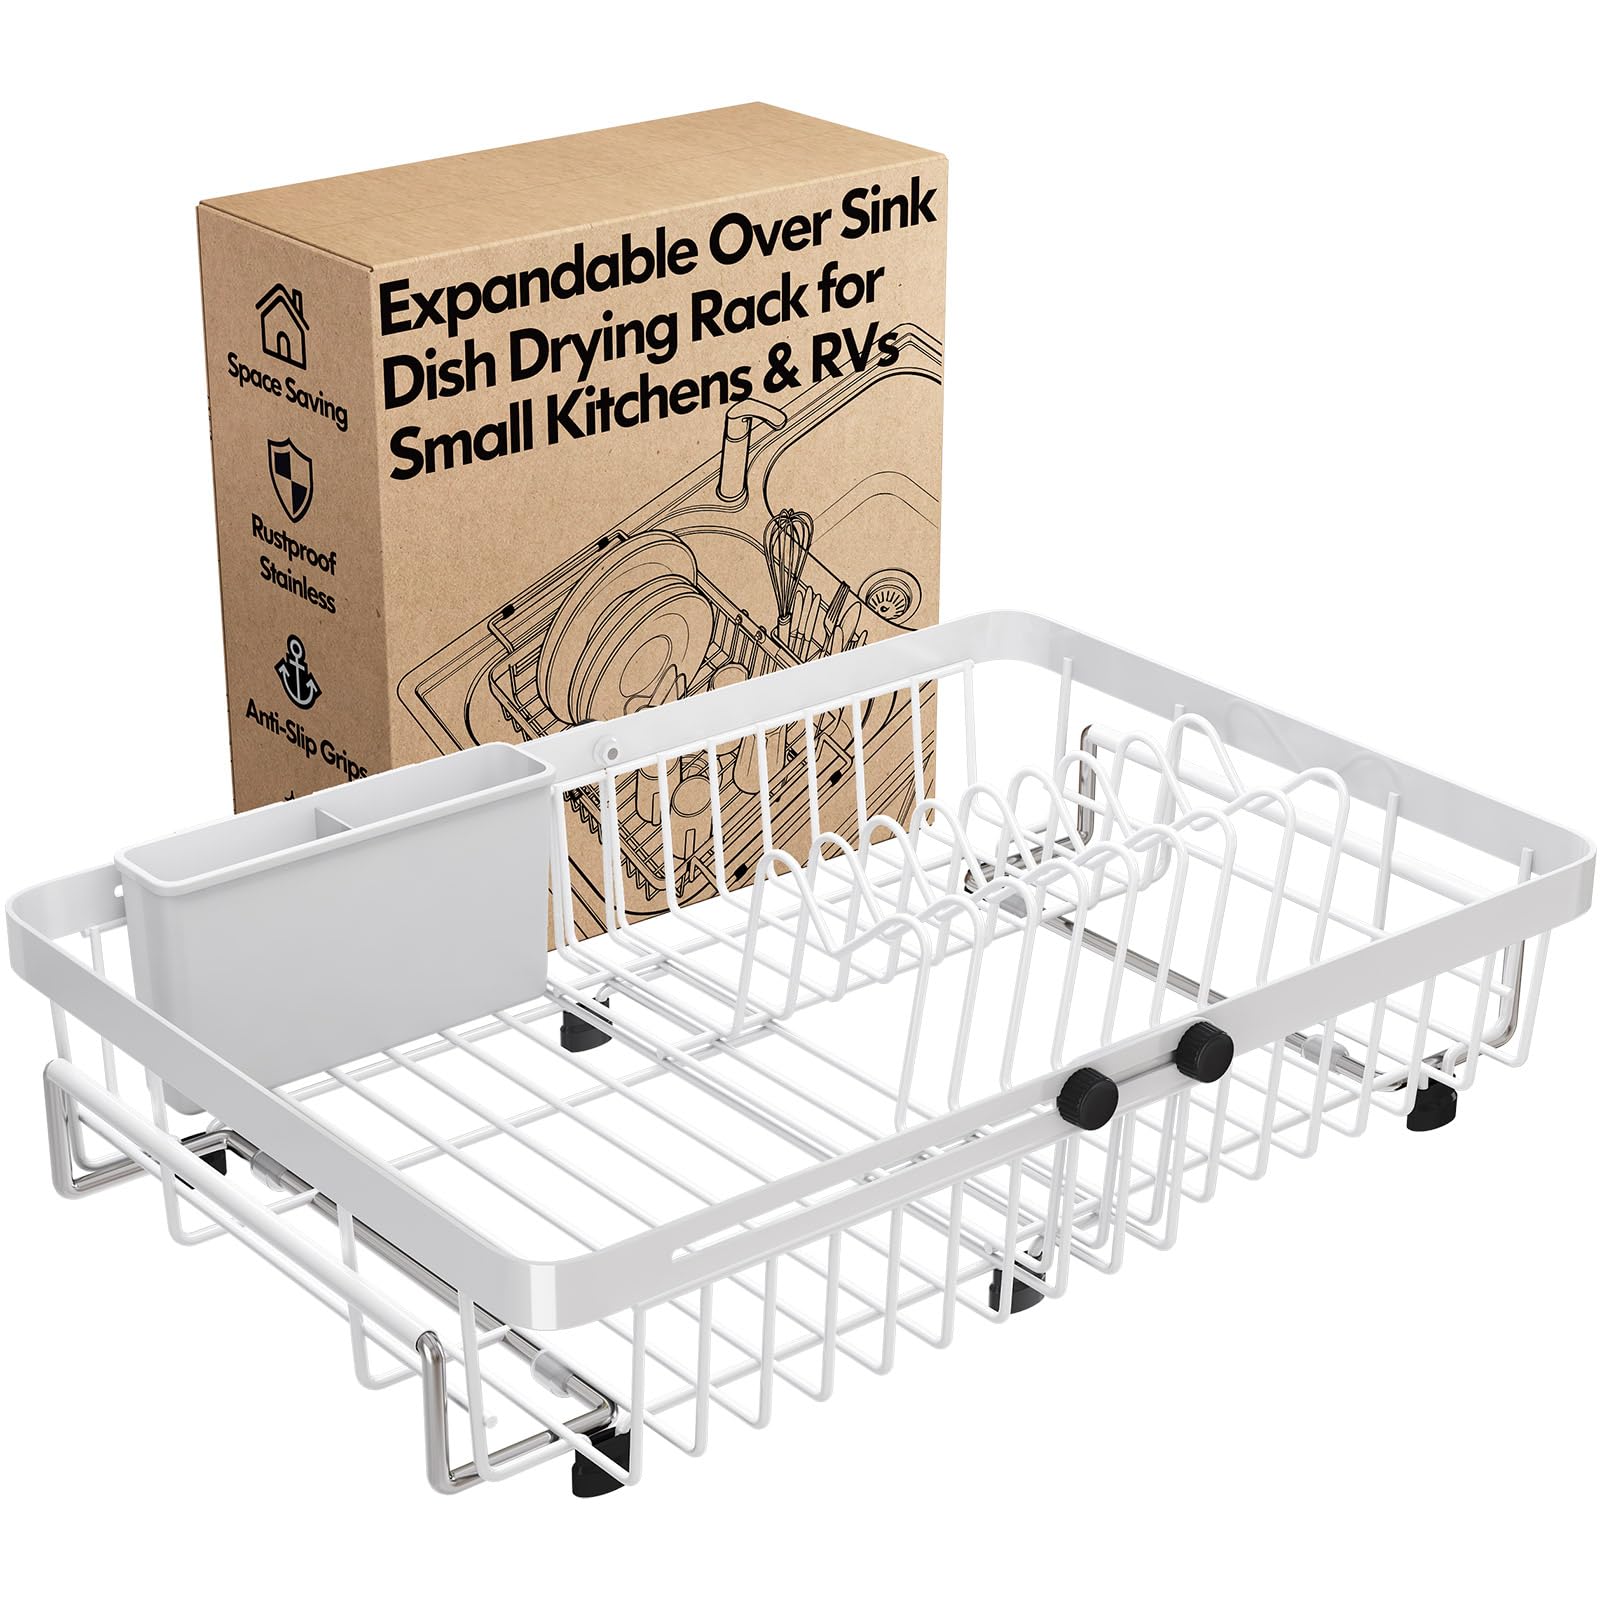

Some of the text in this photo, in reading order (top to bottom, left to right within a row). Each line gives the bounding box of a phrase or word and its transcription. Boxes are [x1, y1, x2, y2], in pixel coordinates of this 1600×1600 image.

[379, 175, 938, 339] Expandable Over Sink
[382, 260, 885, 410] Dish Drying Rack for
[227, 351, 349, 433] Space Saving
[389, 321, 900, 481] Small Kitchens & RVs
[251, 512, 337, 577] Rustproof
[259, 555, 337, 615] Stainless
[245, 697, 368, 783] Anti-Slip Grips
